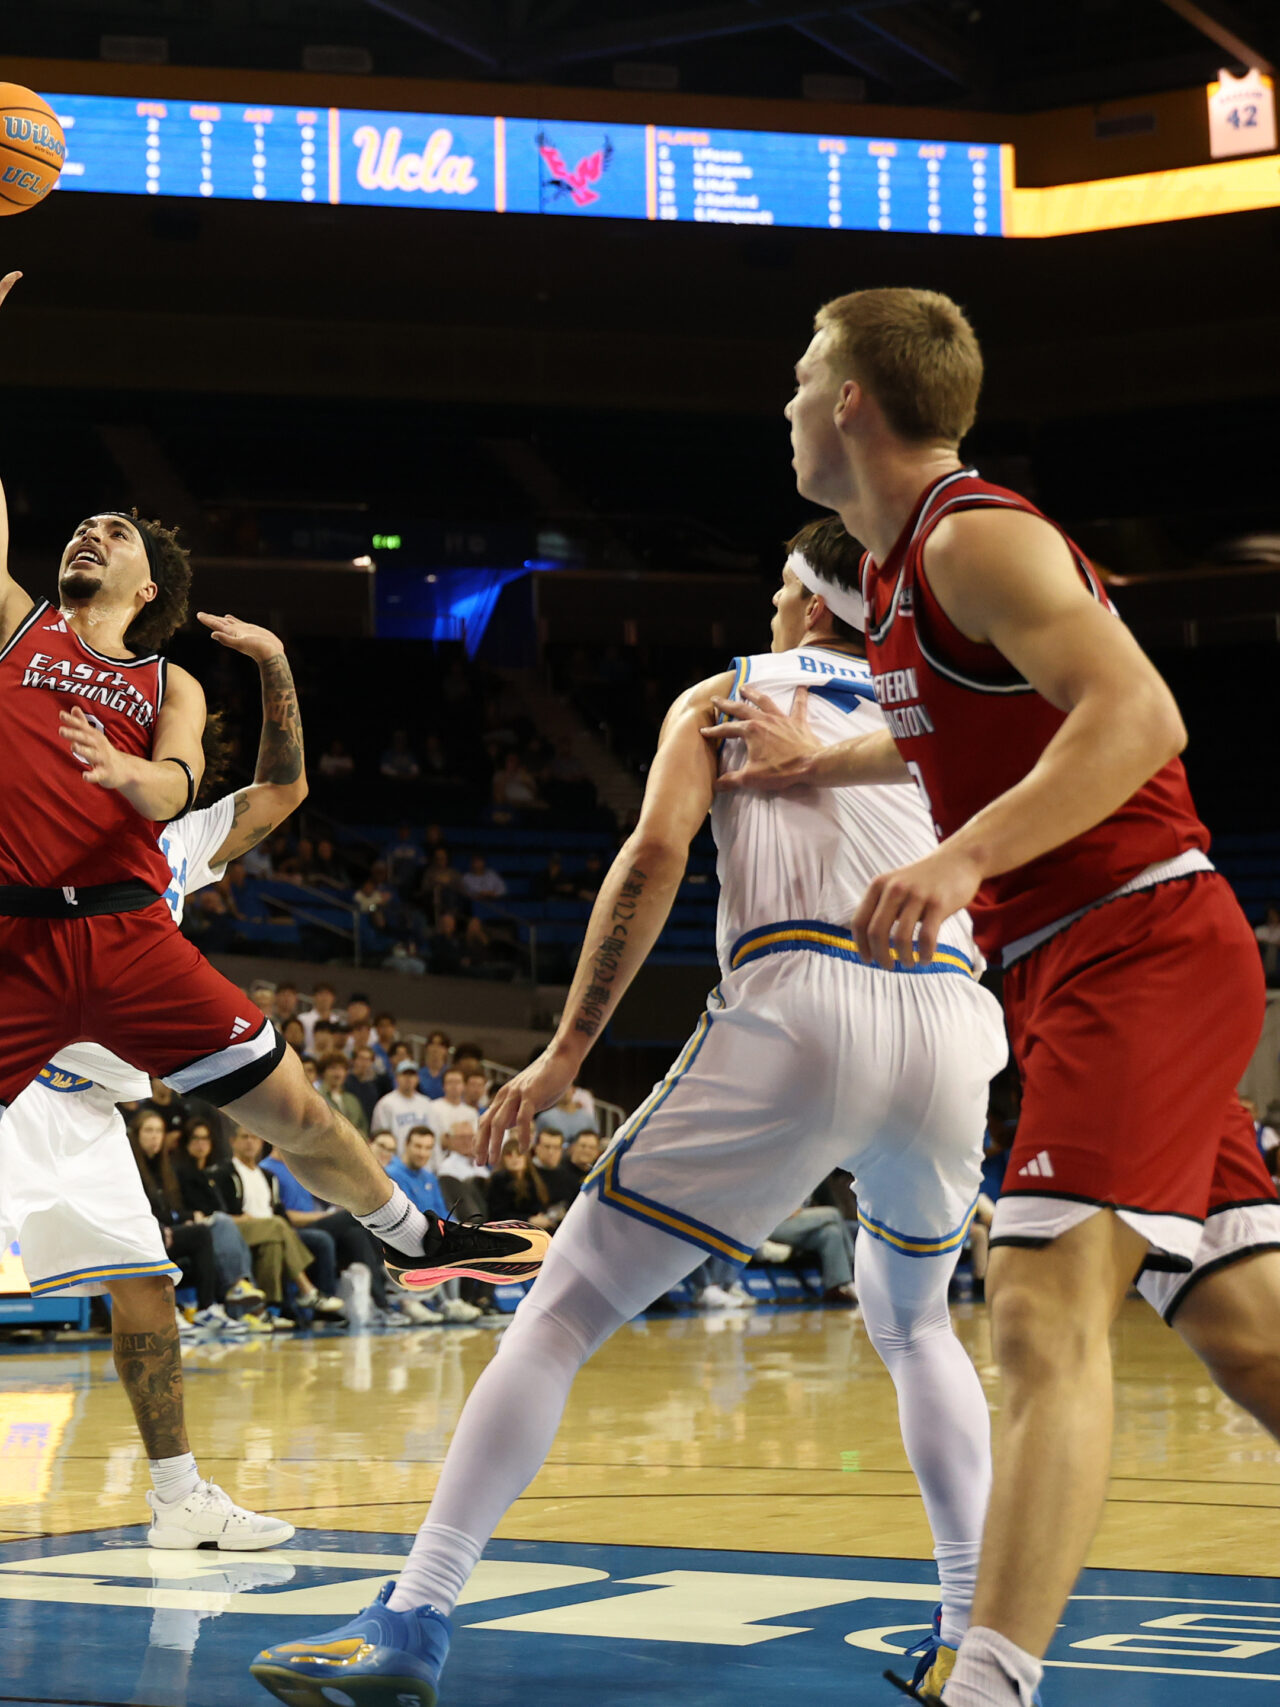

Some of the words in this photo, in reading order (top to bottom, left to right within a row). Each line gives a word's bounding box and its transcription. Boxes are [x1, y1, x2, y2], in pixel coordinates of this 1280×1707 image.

[1227, 105, 1258, 129] 42
[2, 165, 51, 198] UCLA
[22, 669, 154, 728] WASHINGTO
